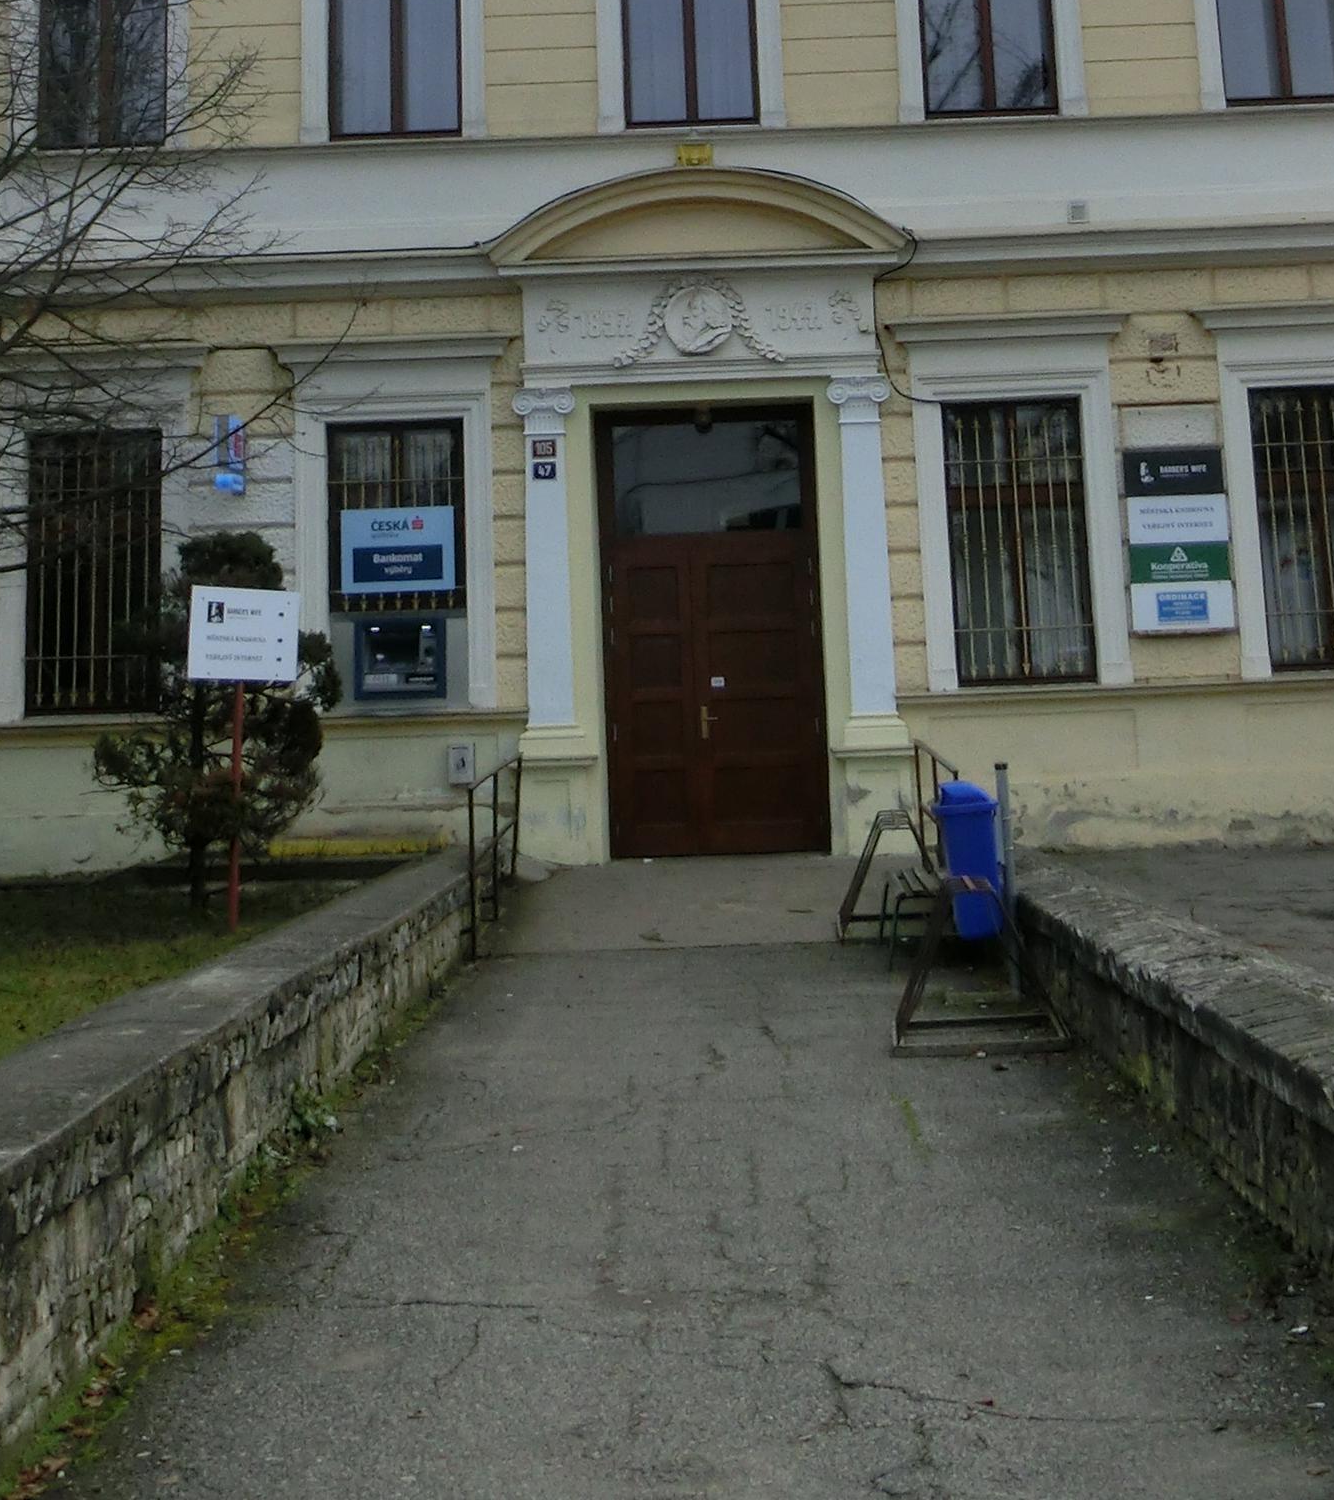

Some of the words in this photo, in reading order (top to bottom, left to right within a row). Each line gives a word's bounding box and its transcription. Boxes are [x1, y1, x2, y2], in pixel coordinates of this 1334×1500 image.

[535, 441, 553, 455] 105
[538, 464, 552, 476] 47
[371, 518, 410, 532] ČESKÁ
[373, 553, 423, 563] Bankomat
[1150, 561, 1209, 572] Kooperativa
